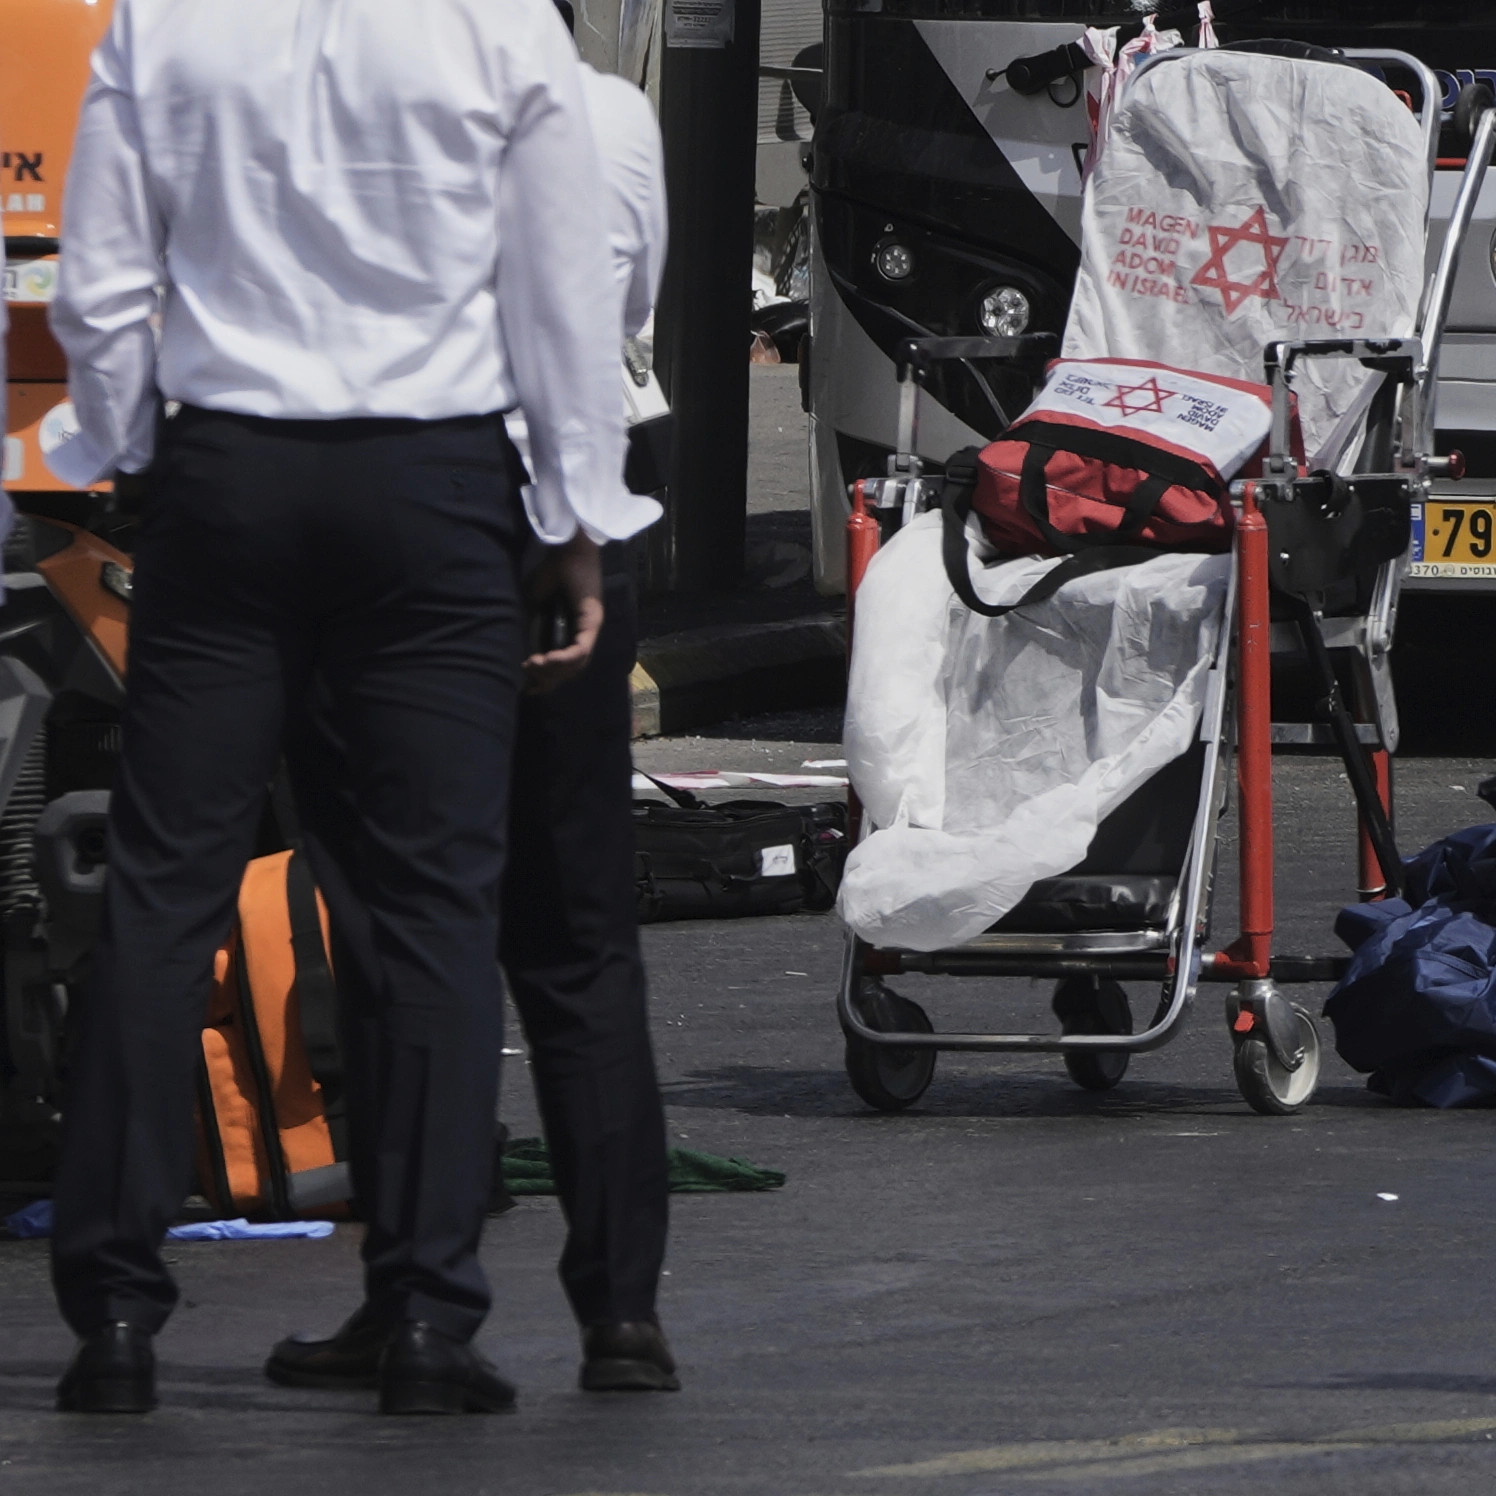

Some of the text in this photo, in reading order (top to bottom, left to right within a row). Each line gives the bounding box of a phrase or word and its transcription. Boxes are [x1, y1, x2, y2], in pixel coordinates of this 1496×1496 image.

[1126, 207, 1199, 240] MAGEN
[1340, 244, 1378, 268] מגן
[1314, 272, 1373, 297] אדום
